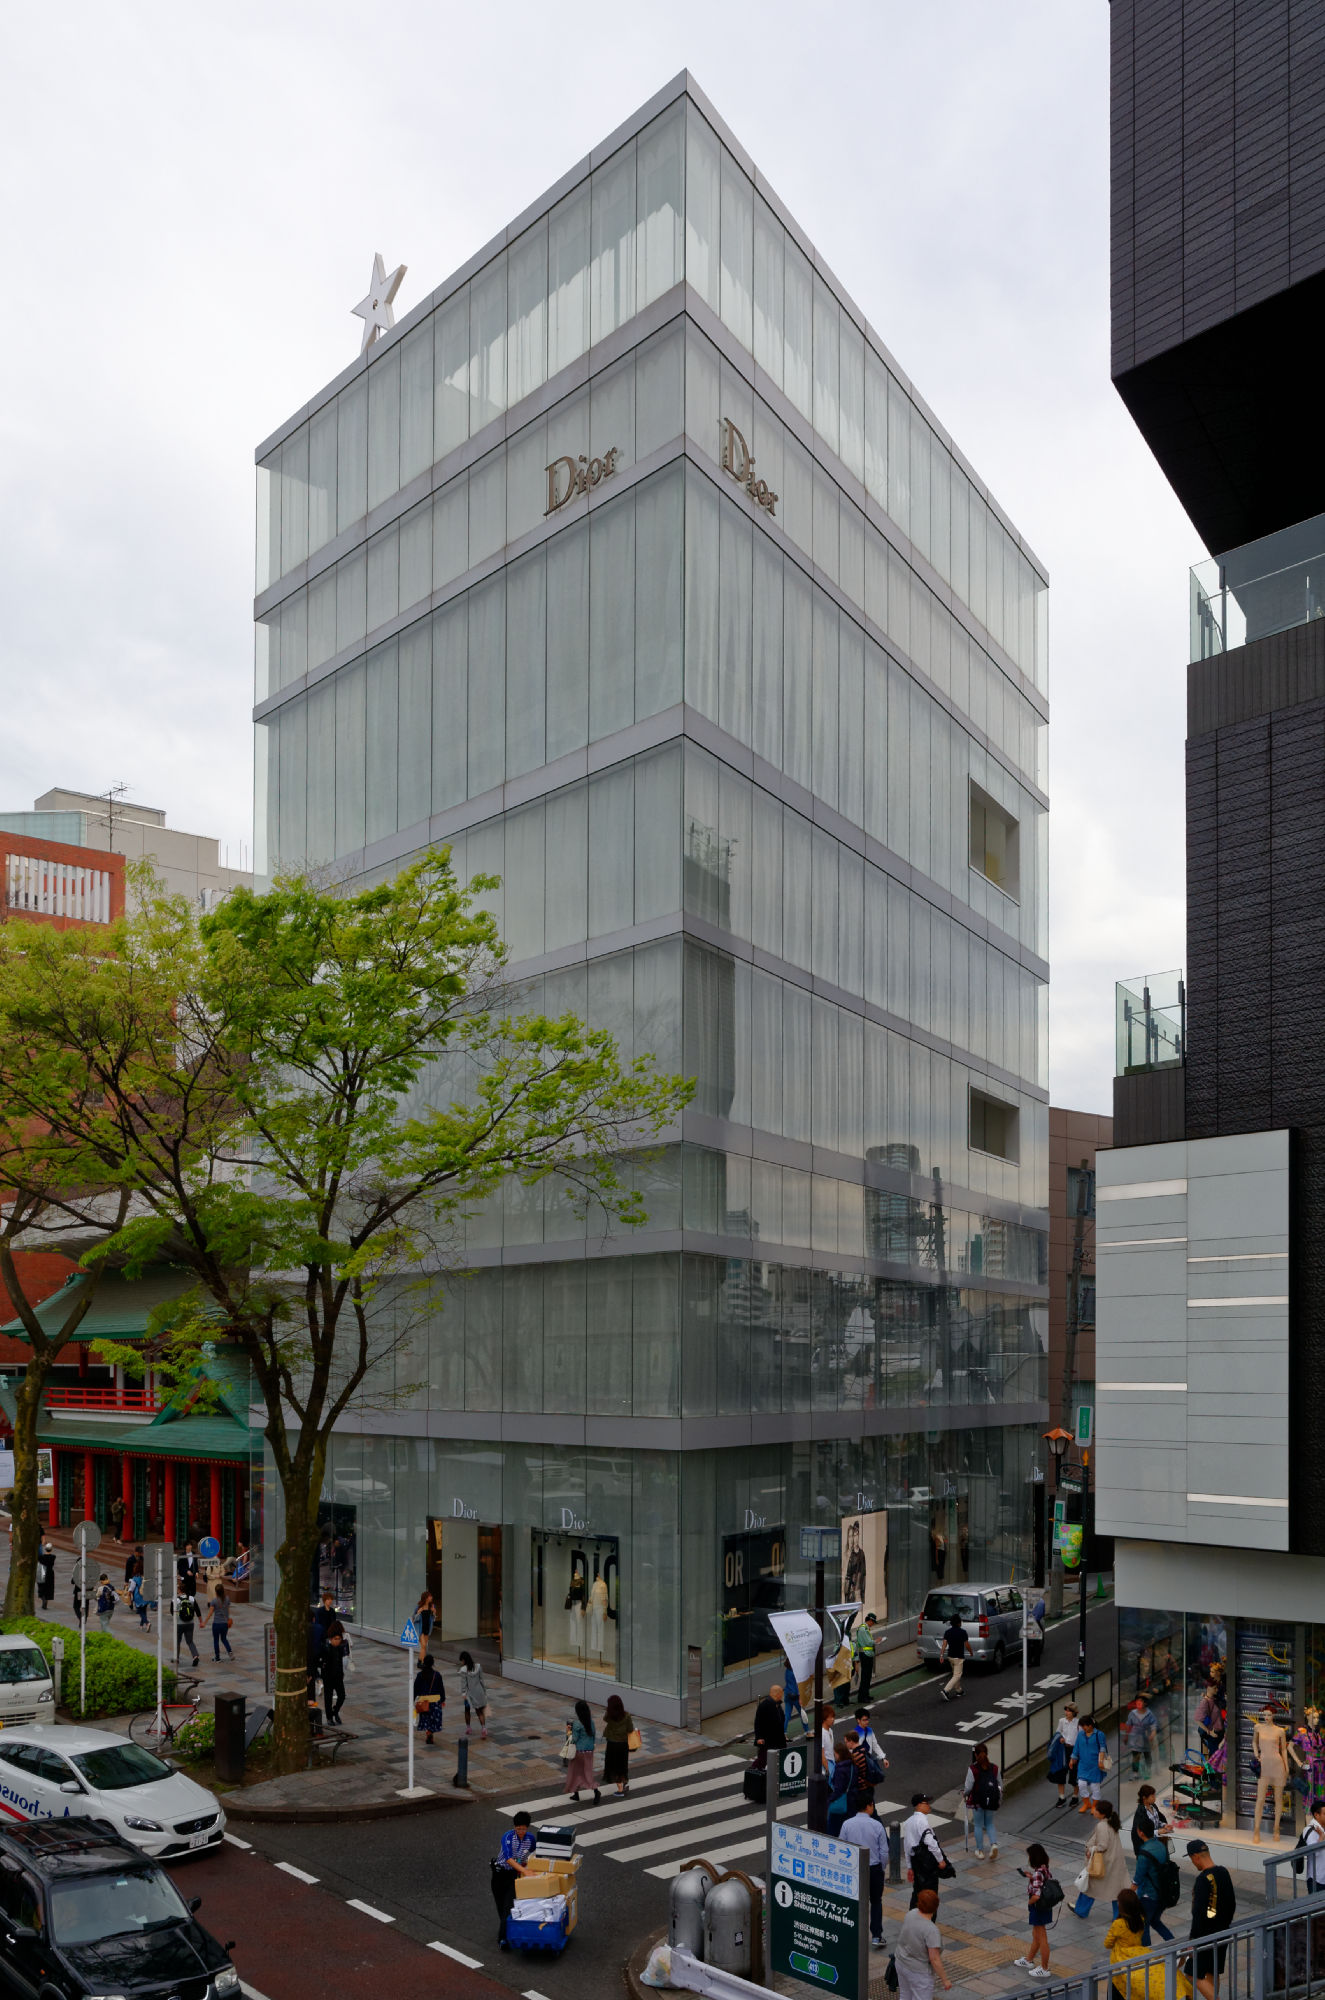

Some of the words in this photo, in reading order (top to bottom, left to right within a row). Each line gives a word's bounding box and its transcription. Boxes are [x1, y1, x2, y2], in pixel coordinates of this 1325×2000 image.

[722, 417, 779, 517] Dior
[543, 446, 618, 517] Dior
[1034, 1466, 1044, 1481] Dior
[453, 1498, 478, 1520] Dior
[857, 1492, 874, 1511] Dior
[560, 1507, 590, 1530] Dior
[744, 1509, 767, 1530] Dior
[725, 1551, 744, 1588] OR
[955, 1674, 1079, 1732] 止まれ
[778, 1828, 837, 1855] 明治神宮
[785, 1841, 797, 1852] Meiji
[813, 1849, 829, 1860] Shrine
[794, 1890, 850, 1915] 渋谷区エリアマップ
[794, 1900, 816, 1914] Shibuya
[816, 1907, 828, 1919] City
[828, 1911, 842, 1923] Area
[842, 1916, 855, 1928] Map
[794, 1939, 809, 1950] Shibuya
[809, 1944, 818, 1954] City
